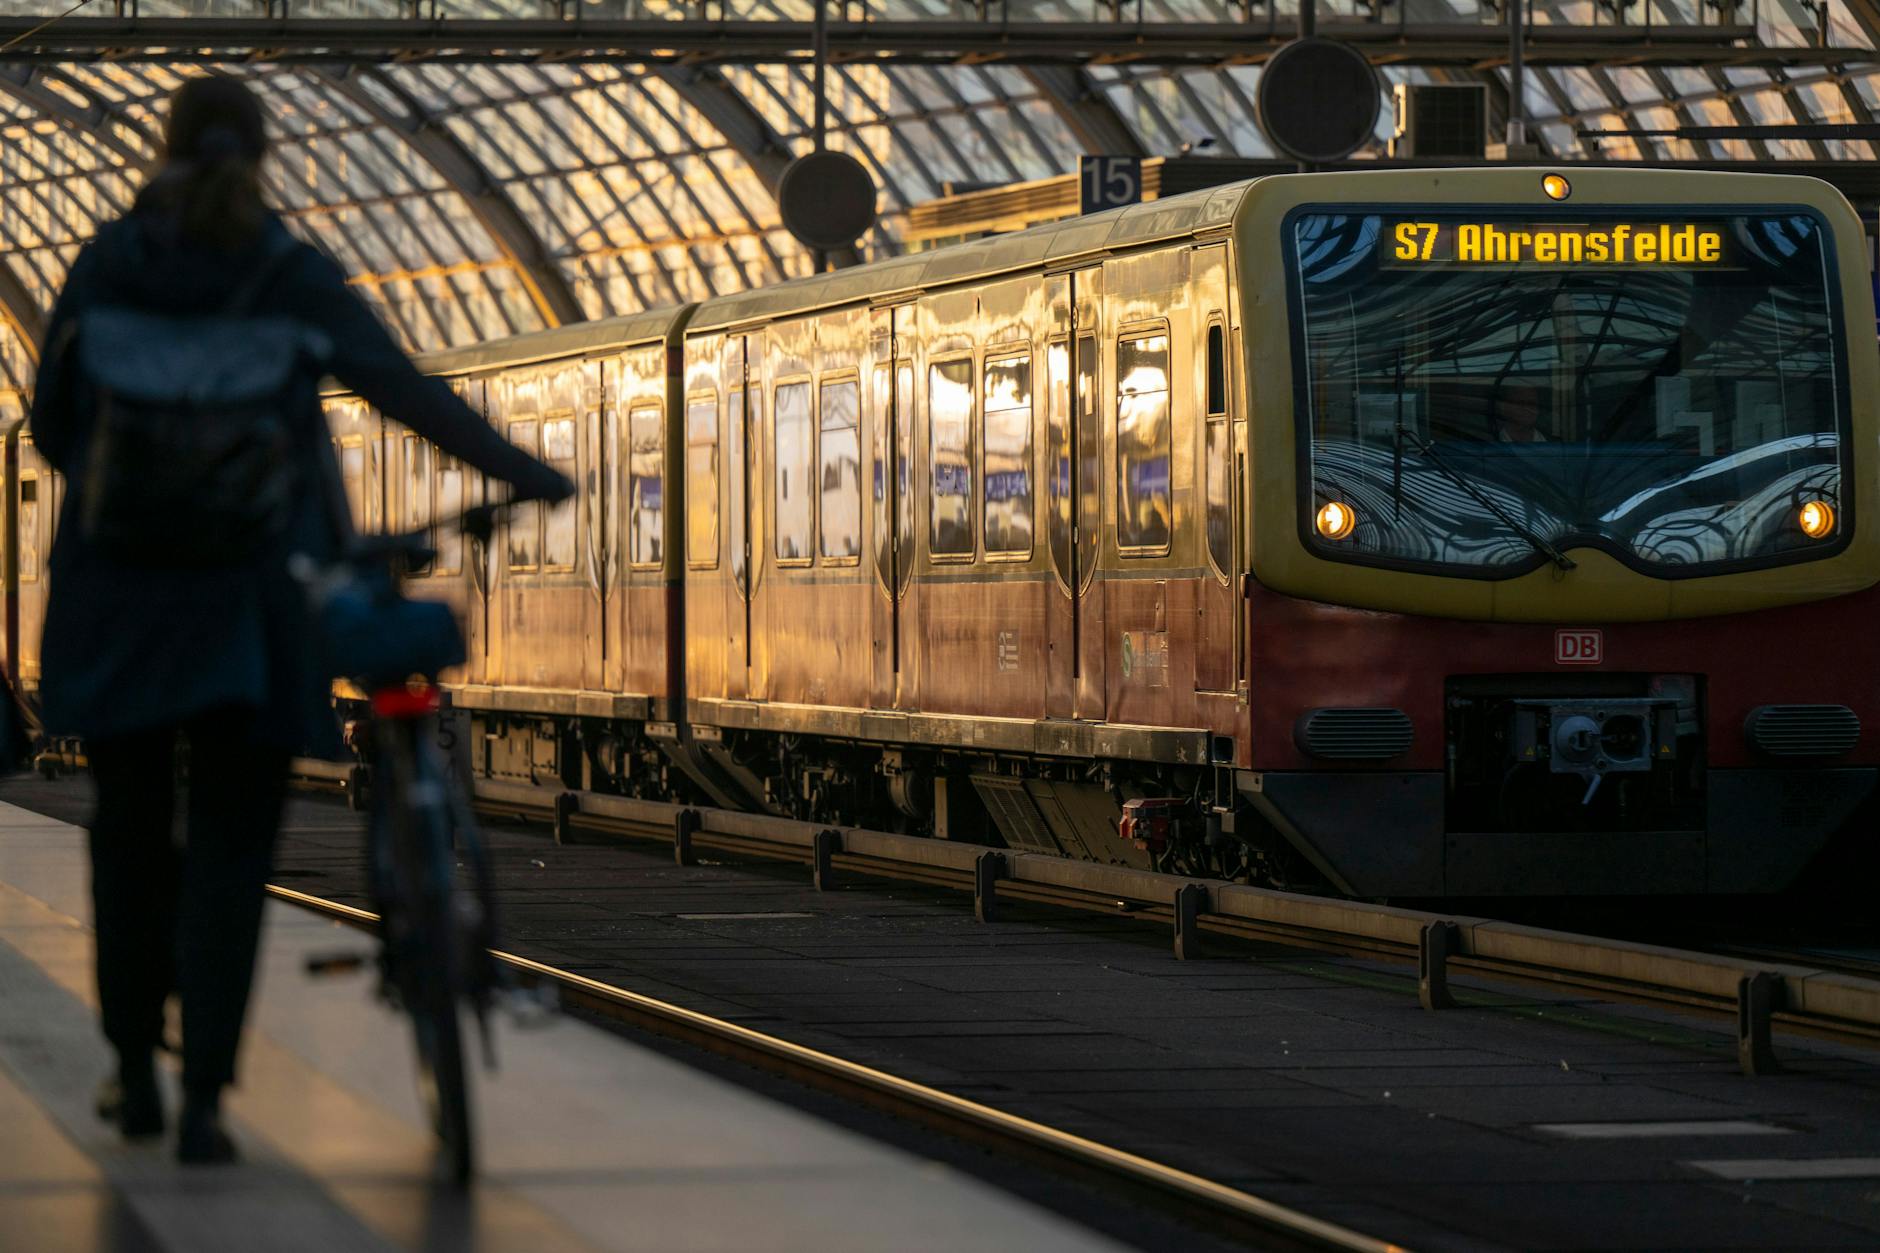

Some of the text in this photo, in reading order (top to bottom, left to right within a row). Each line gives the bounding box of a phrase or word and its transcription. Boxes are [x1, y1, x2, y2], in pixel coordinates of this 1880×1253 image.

[1084, 158, 1135, 204] 15
[1394, 222, 1722, 263] S7 Ahrensfelde
[1560, 634, 1597, 659] DB
[437, 718, 458, 750] 5
